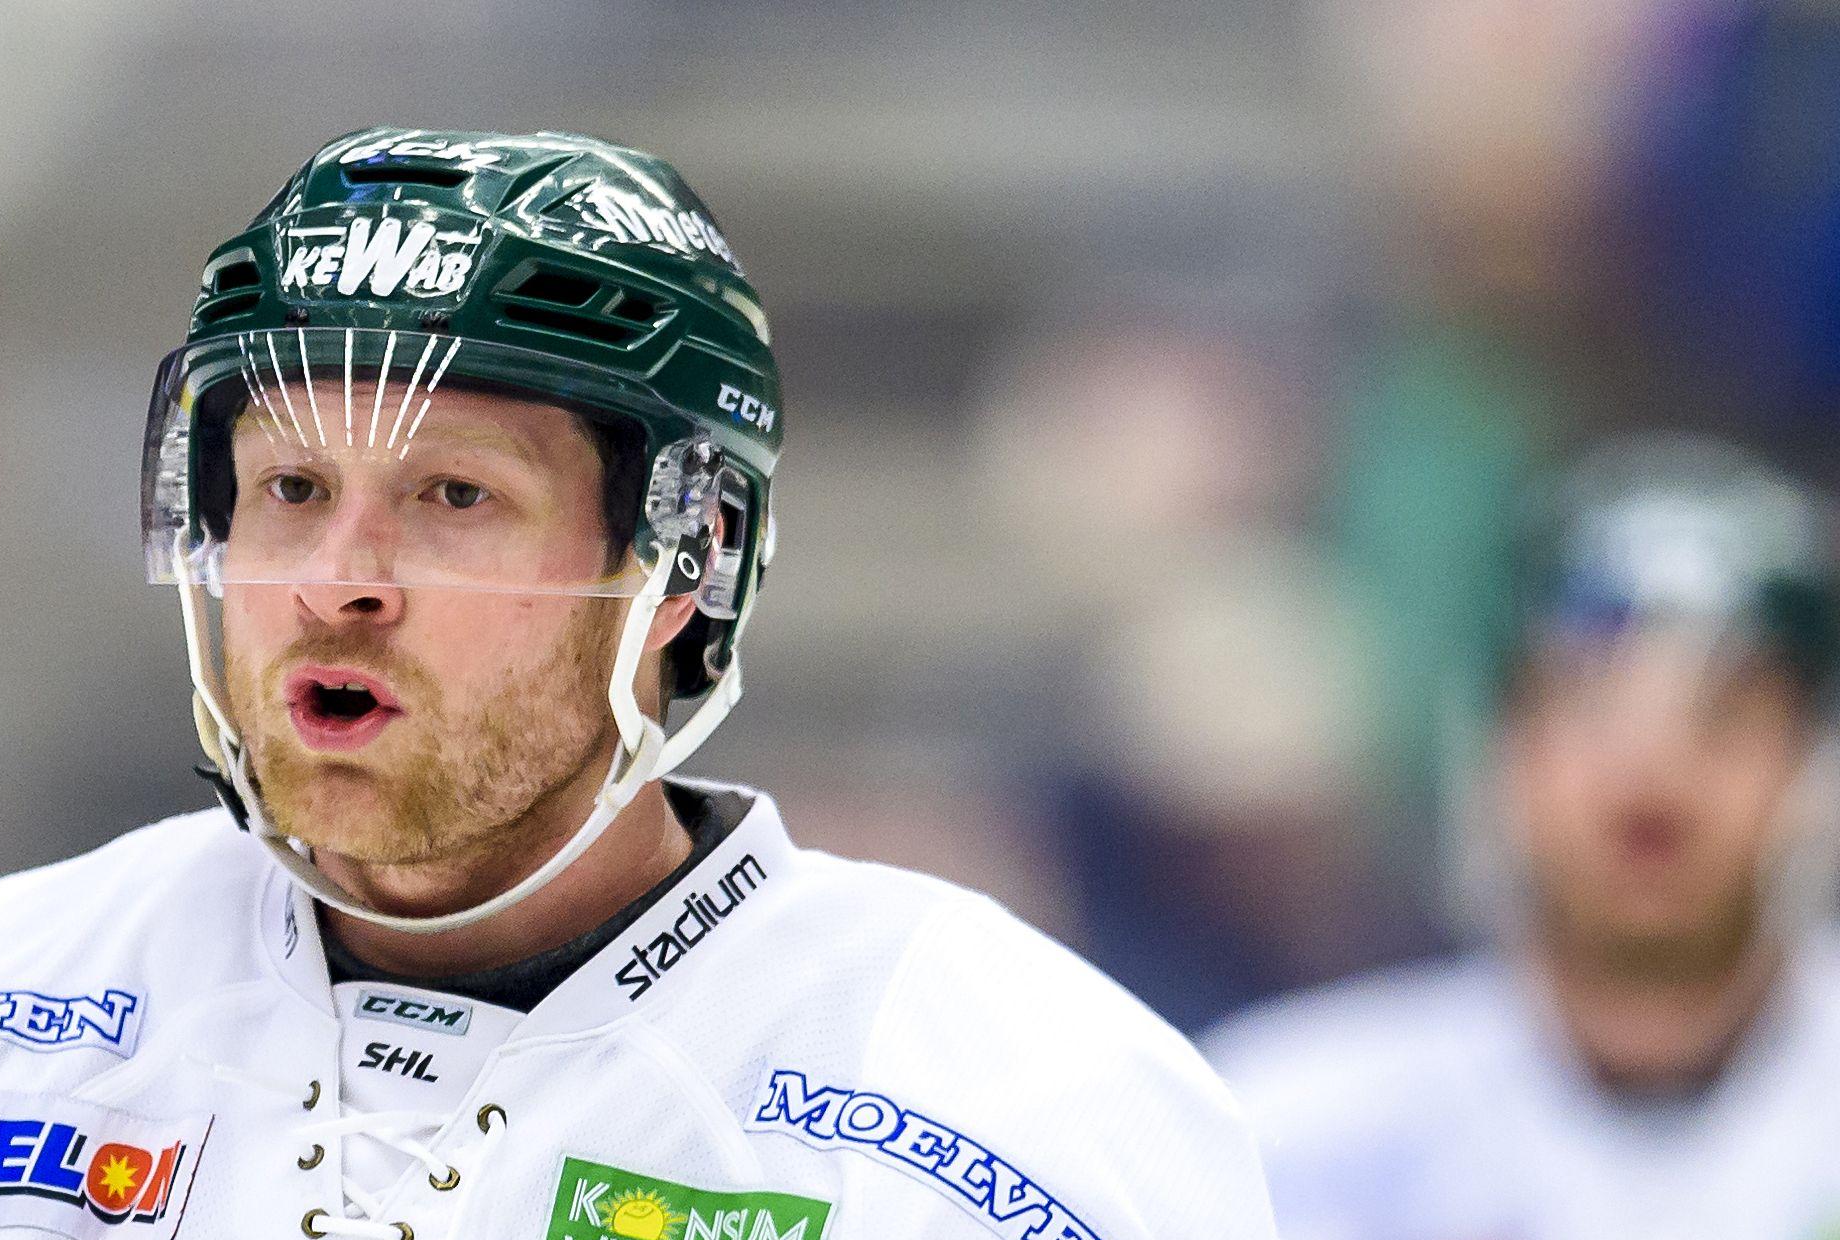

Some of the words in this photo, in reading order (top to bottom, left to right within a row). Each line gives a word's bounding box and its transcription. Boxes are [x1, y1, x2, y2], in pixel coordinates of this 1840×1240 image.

[717, 382, 775, 433] CCM
[615, 854, 768, 1002] stadium
[362, 996, 464, 1027] CCM
[358, 1042, 439, 1083] SHL
